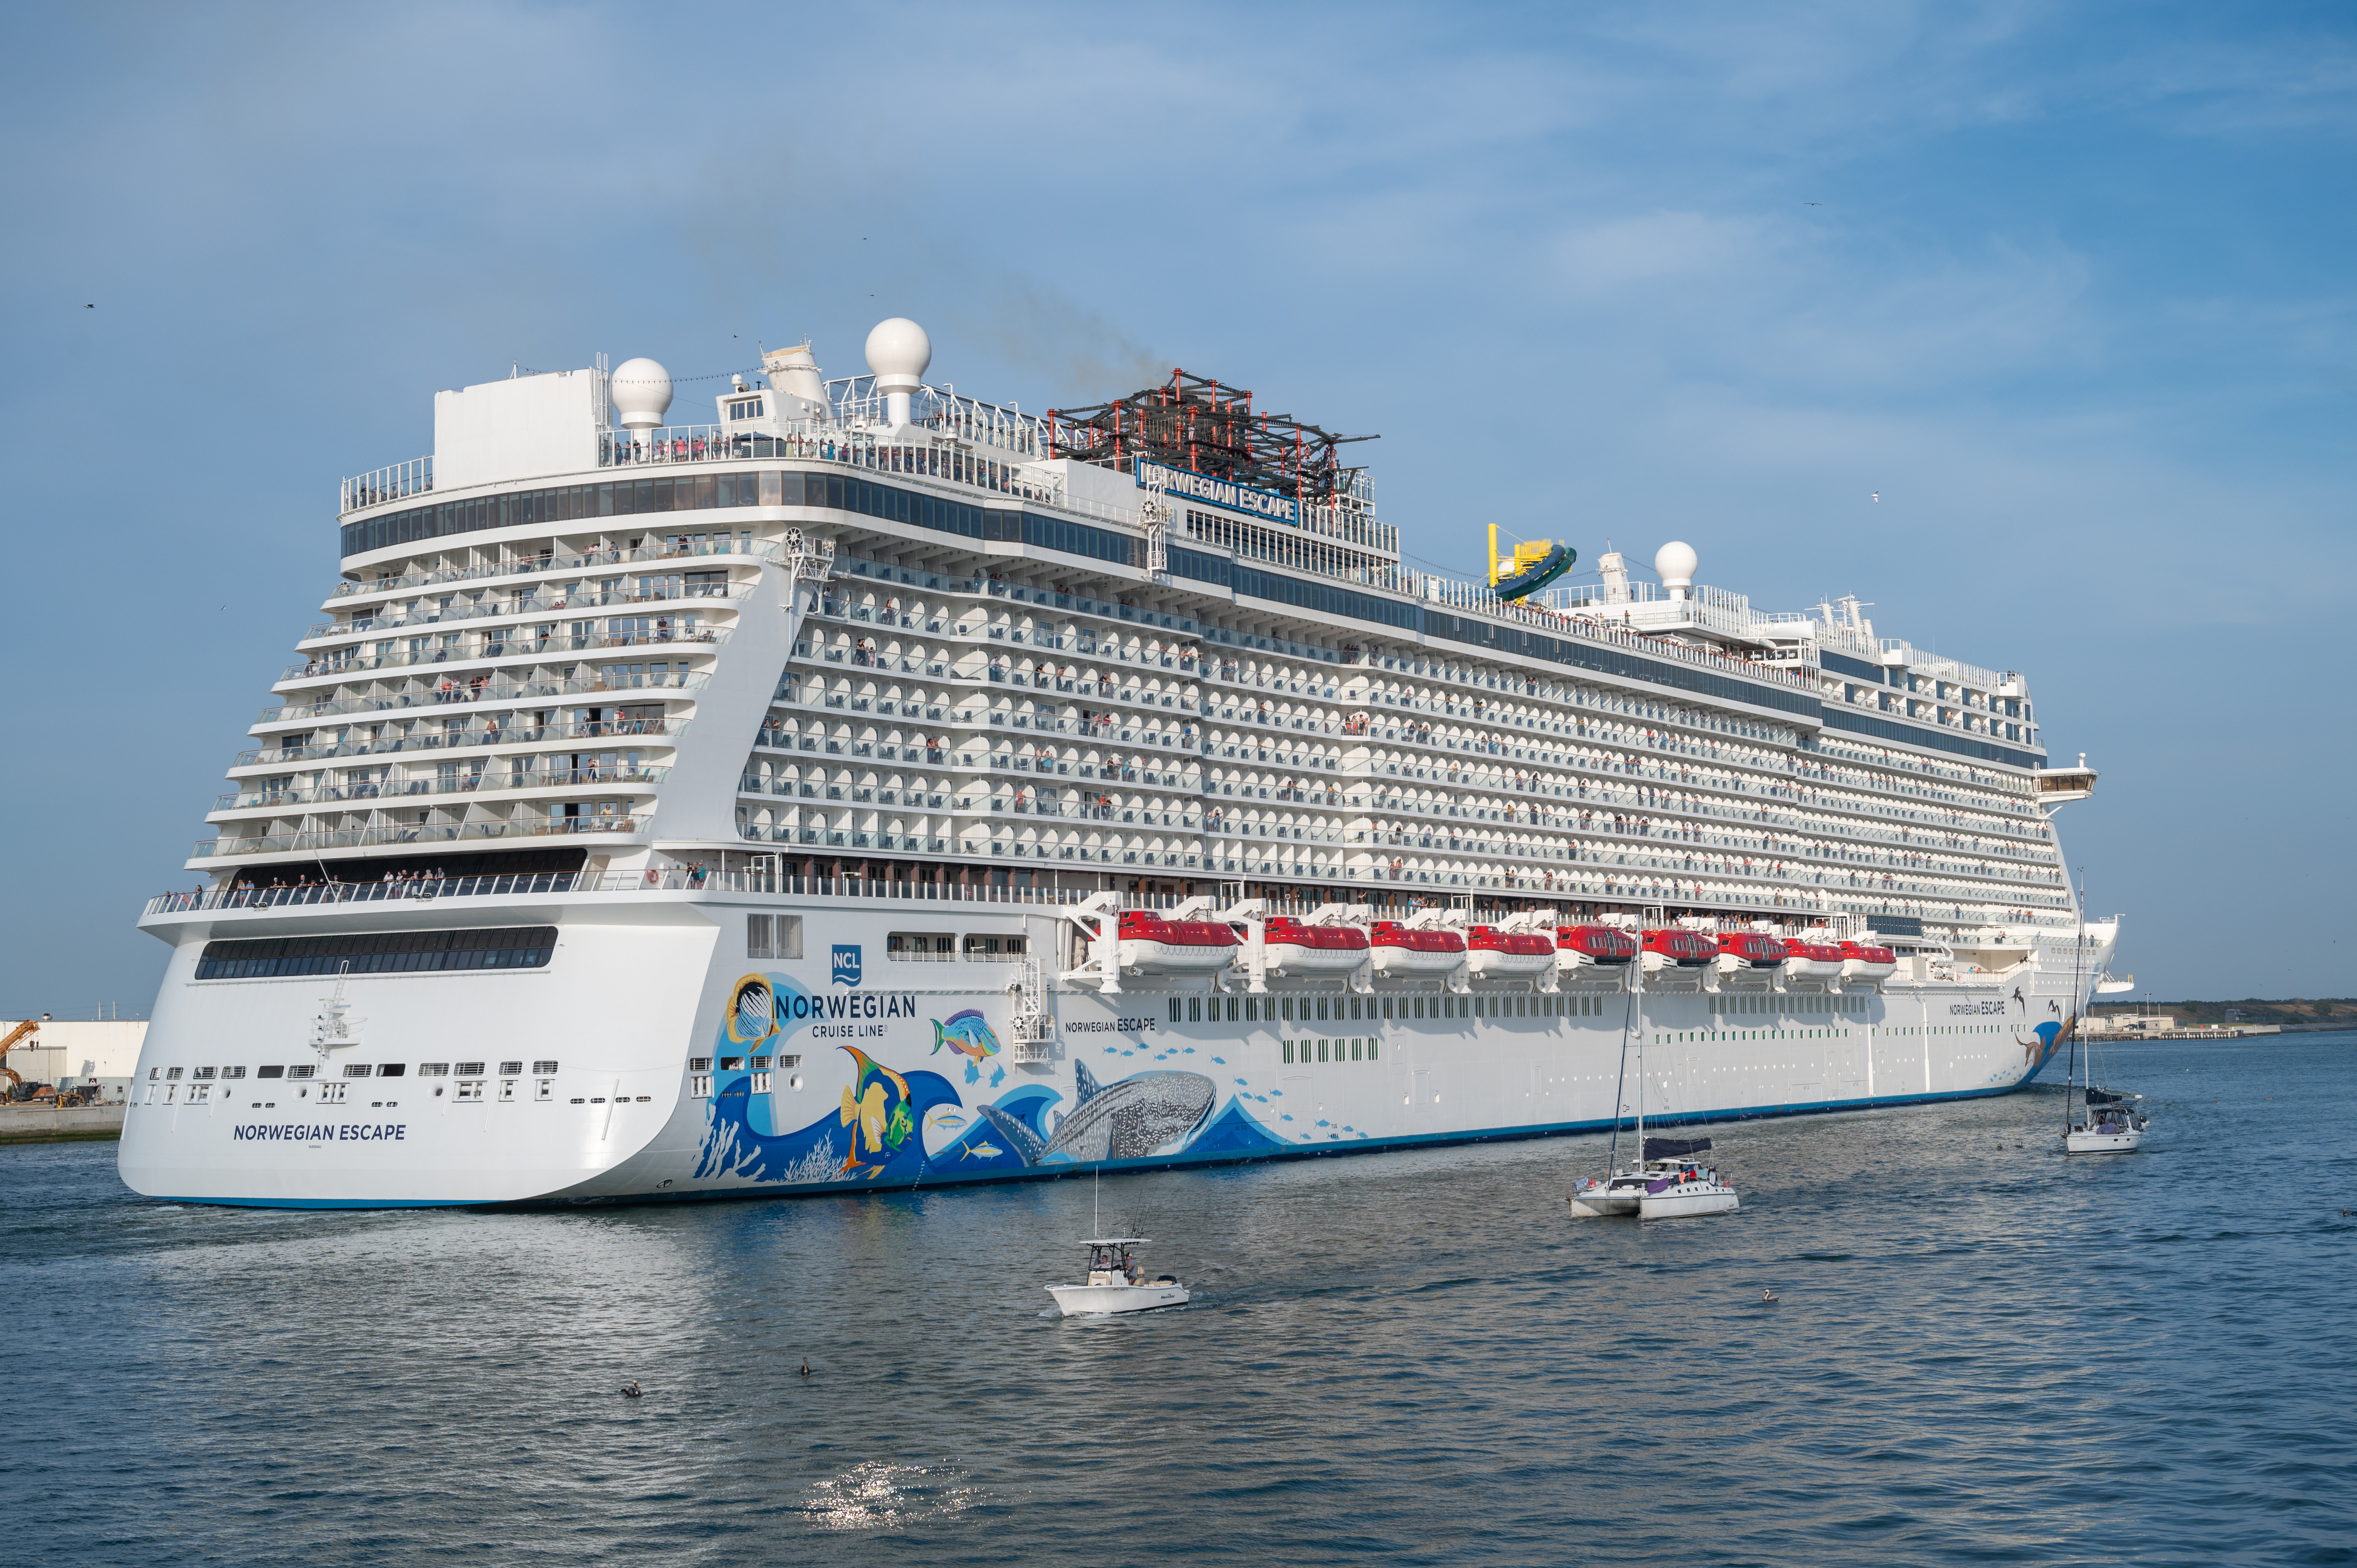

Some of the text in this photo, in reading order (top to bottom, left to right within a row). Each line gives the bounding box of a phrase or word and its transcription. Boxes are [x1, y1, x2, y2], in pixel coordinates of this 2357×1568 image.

[1141, 462, 1297, 520] NORWEGIAN ESCAPE
[834, 952, 860, 968] NCL
[776, 995, 915, 1019] NORWEGIAN
[1950, 1001, 2005, 1015] NORWEGIAN ESCAPE
[812, 1025, 854, 1038] CRUISE
[1066, 1018, 1155, 1033] NORWEGIAN ESCAPE
[234, 1125, 406, 1140] NORWEGIAN ESCAPE
